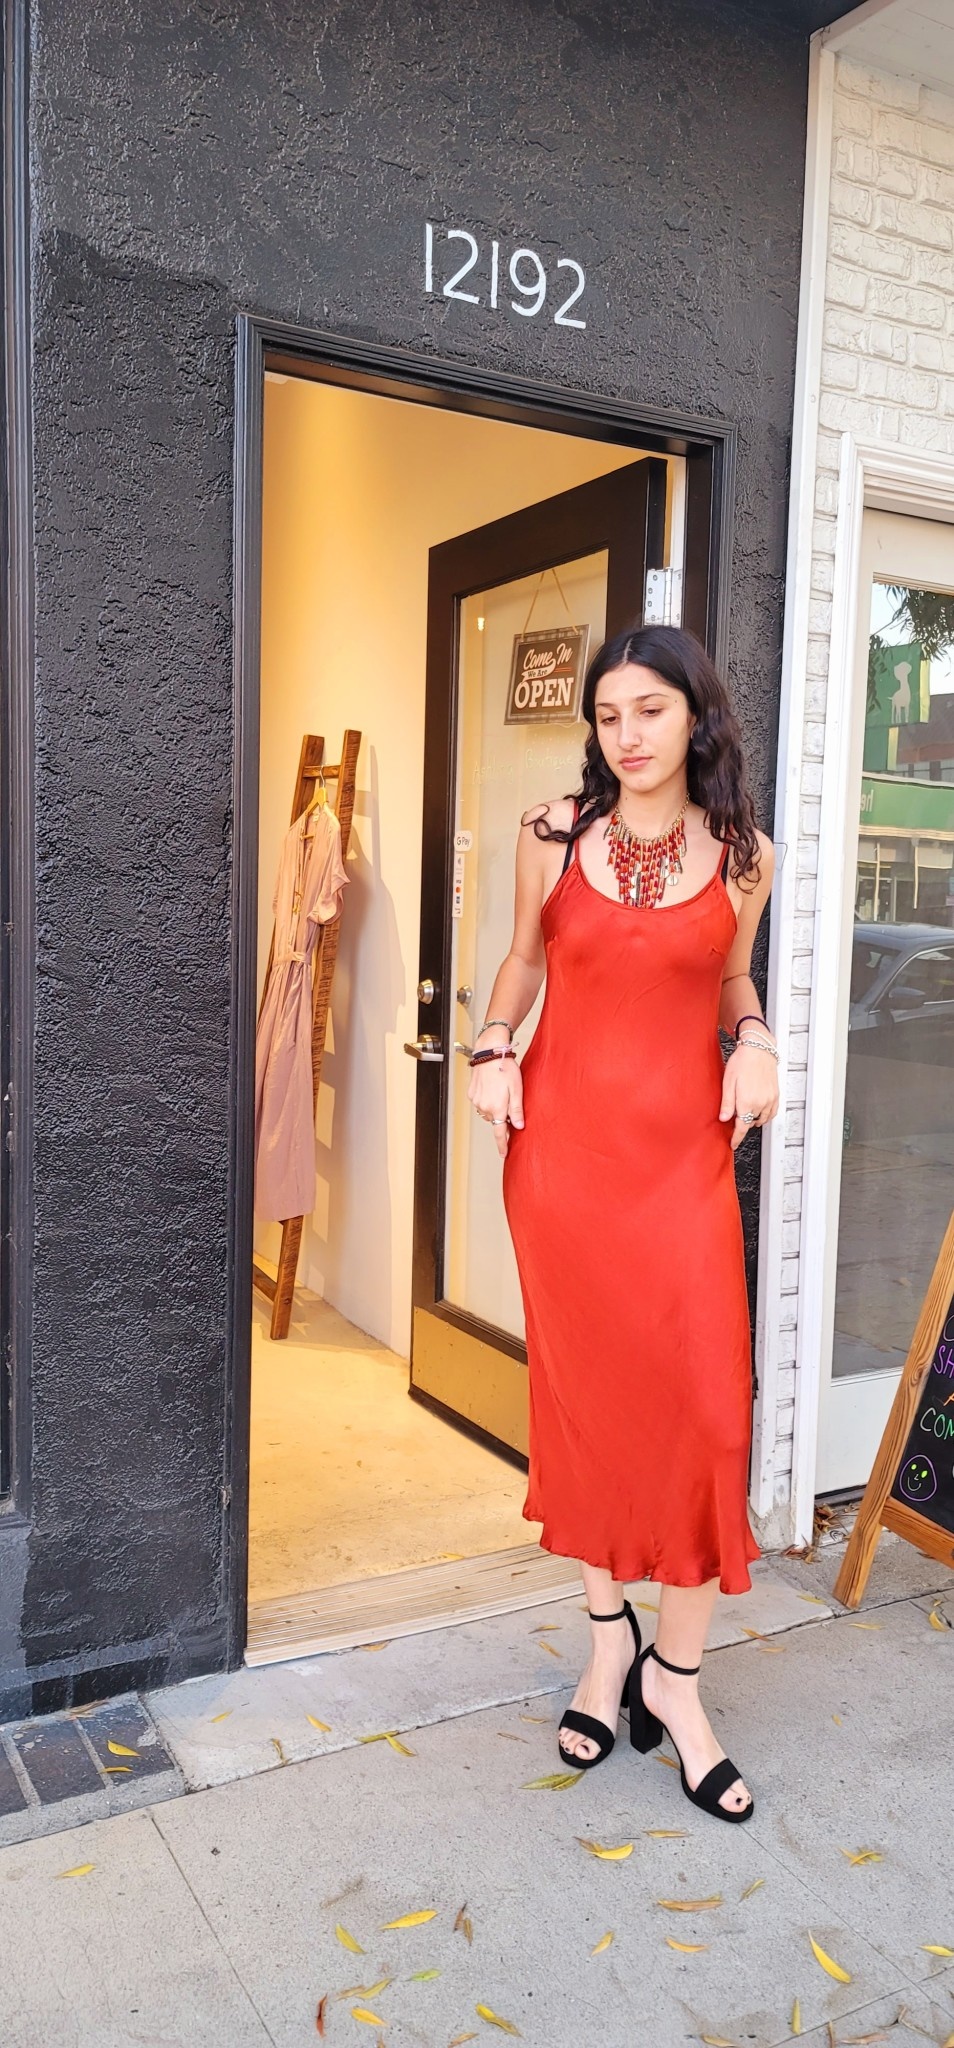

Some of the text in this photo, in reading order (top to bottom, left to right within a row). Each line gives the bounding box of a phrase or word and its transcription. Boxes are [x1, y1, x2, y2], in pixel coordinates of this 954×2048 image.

[425, 223, 586, 329] 12192
[523, 643, 573, 670] Come In
[537, 669, 548, 677] Are
[514, 677, 574, 709] OPEN
